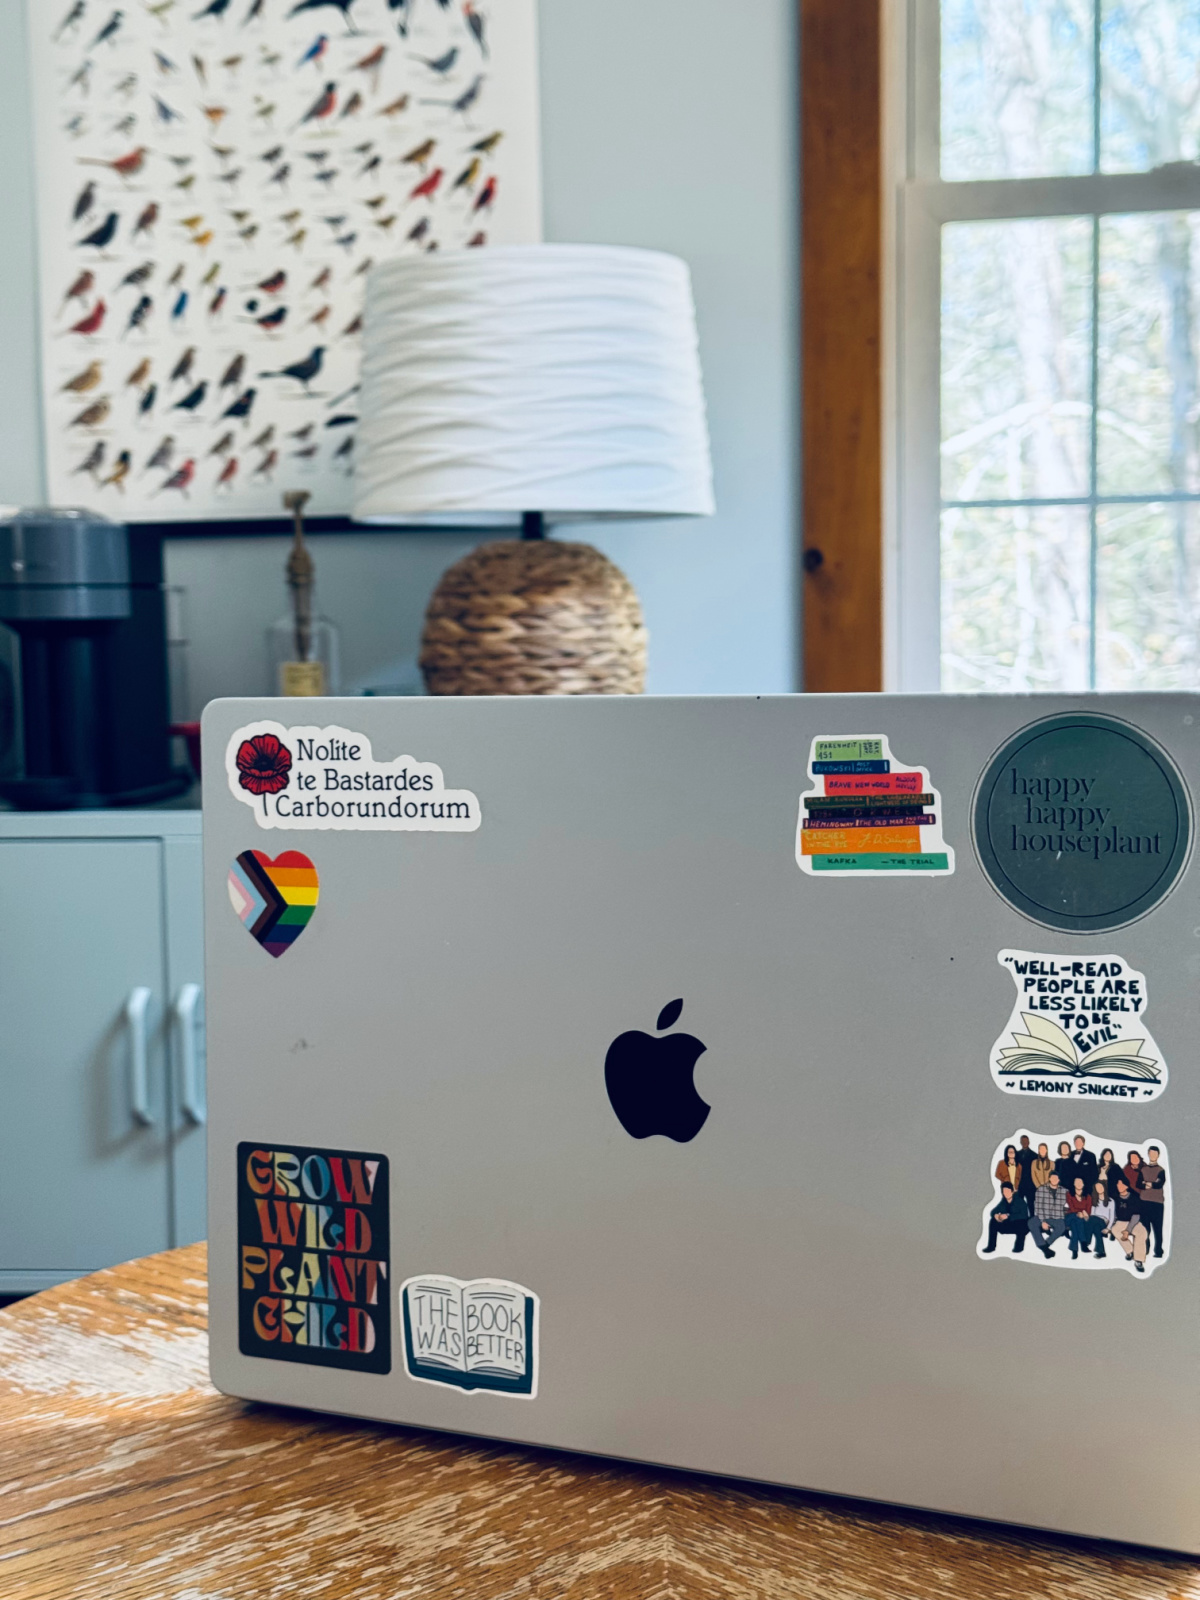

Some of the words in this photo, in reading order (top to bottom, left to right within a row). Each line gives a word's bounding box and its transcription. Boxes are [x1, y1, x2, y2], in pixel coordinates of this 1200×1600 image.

[297, 738, 361, 761] Nolite
[818, 751, 832, 759] 451
[297, 771, 316, 791] te
[324, 768, 433, 791] Bastardes
[1011, 768, 1096, 802] happy
[275, 795, 470, 818] Carborundorum
[1026, 797, 1111, 831] happy
[810, 820, 854, 828] HEMINGWAY
[1011, 825, 1163, 860] houseplant
[1024, 978, 1095, 994] PEOPLE
[1101, 980, 1139, 995] ARE
[1029, 996, 1076, 1011] LESS
[1081, 996, 1142, 1012] LIKELY
[1059, 1014, 1089, 1029] TO
[1092, 1013, 1111, 1025] BE
[1019, 1080, 1073, 1093] LEMONY
[1078, 1083, 1138, 1097] SNICKET
[246, 1150, 380, 1204] GROW
[254, 1199, 372, 1254] WILD
[242, 1245, 387, 1305] PLANT
[253, 1296, 376, 1354] CHILD
[414, 1295, 458, 1331] THE
[467, 1302, 523, 1339] BOOK
[417, 1324, 461, 1356] WAS
[467, 1334, 524, 1363] BETTER
